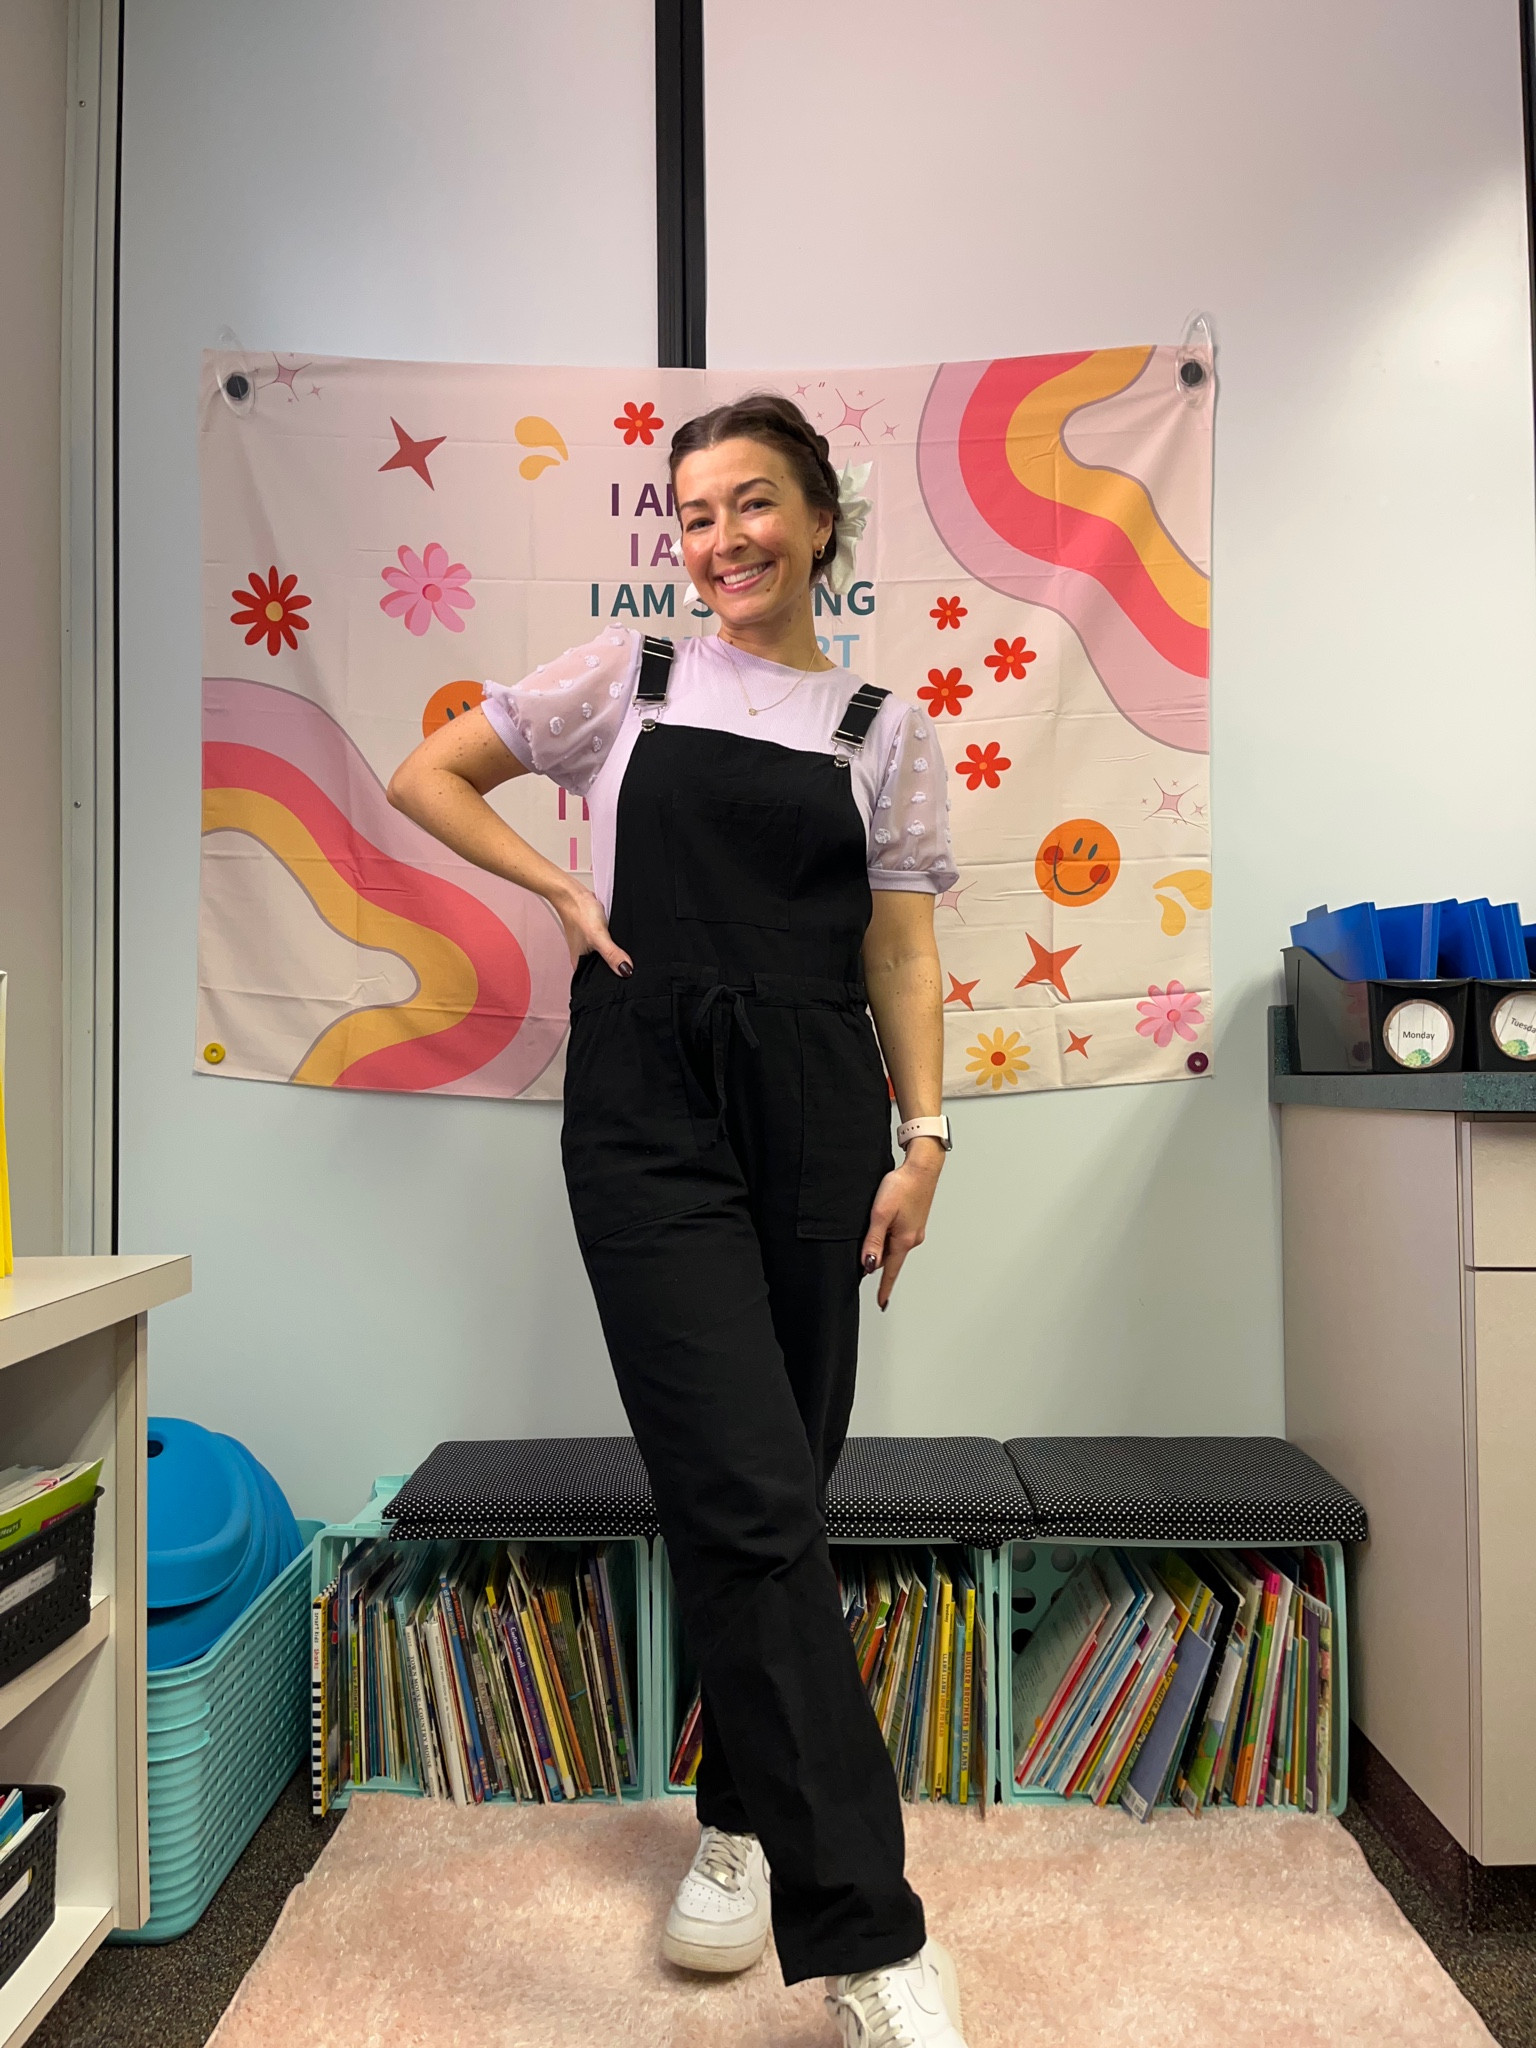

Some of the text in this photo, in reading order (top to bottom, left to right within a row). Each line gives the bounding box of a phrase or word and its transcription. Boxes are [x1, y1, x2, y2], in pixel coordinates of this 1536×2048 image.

[612, 483, 619, 517] I
[630, 533, 686, 567] I A
[591, 583, 599, 617] I
[610, 583, 675, 618] AM
[1402, 1030, 1436, 1041] Monday
[1511, 1017, 1536, 1034] Tuesda
